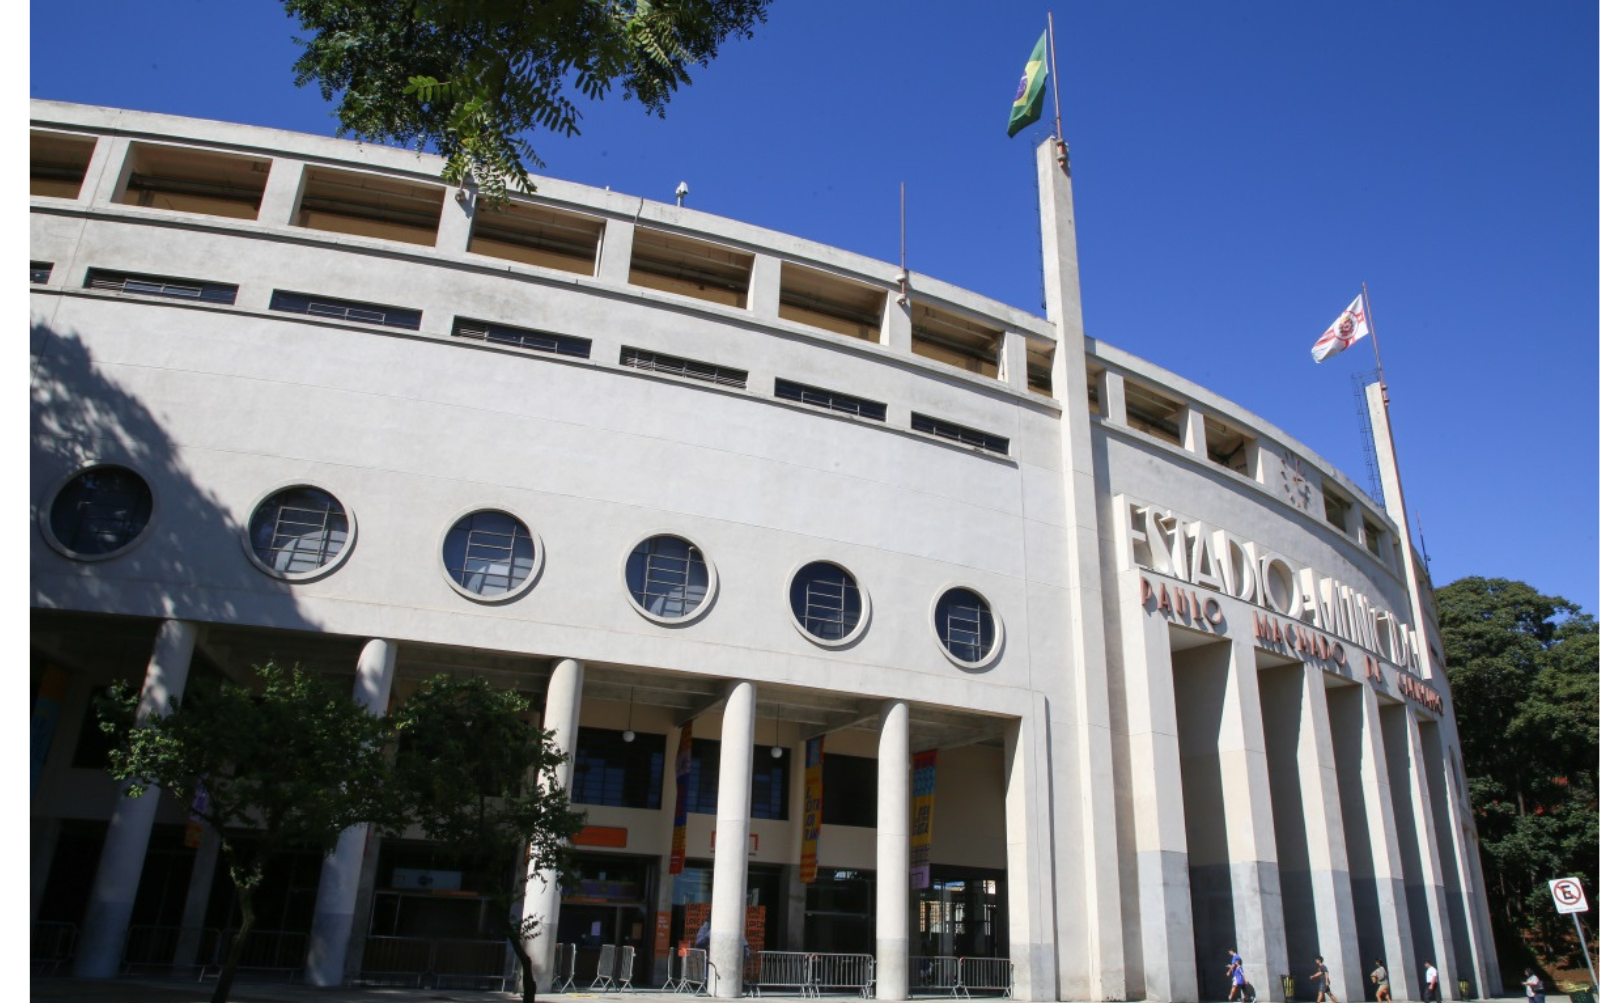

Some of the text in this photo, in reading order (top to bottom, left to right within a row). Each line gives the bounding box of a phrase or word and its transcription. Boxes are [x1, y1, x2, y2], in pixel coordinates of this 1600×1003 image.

[1112, 494, 1303, 618] ESTADIO
[1140, 577, 1222, 625] PAULO
[1252, 610, 1347, 667] MACHADO
[1365, 654, 1382, 684] DE
